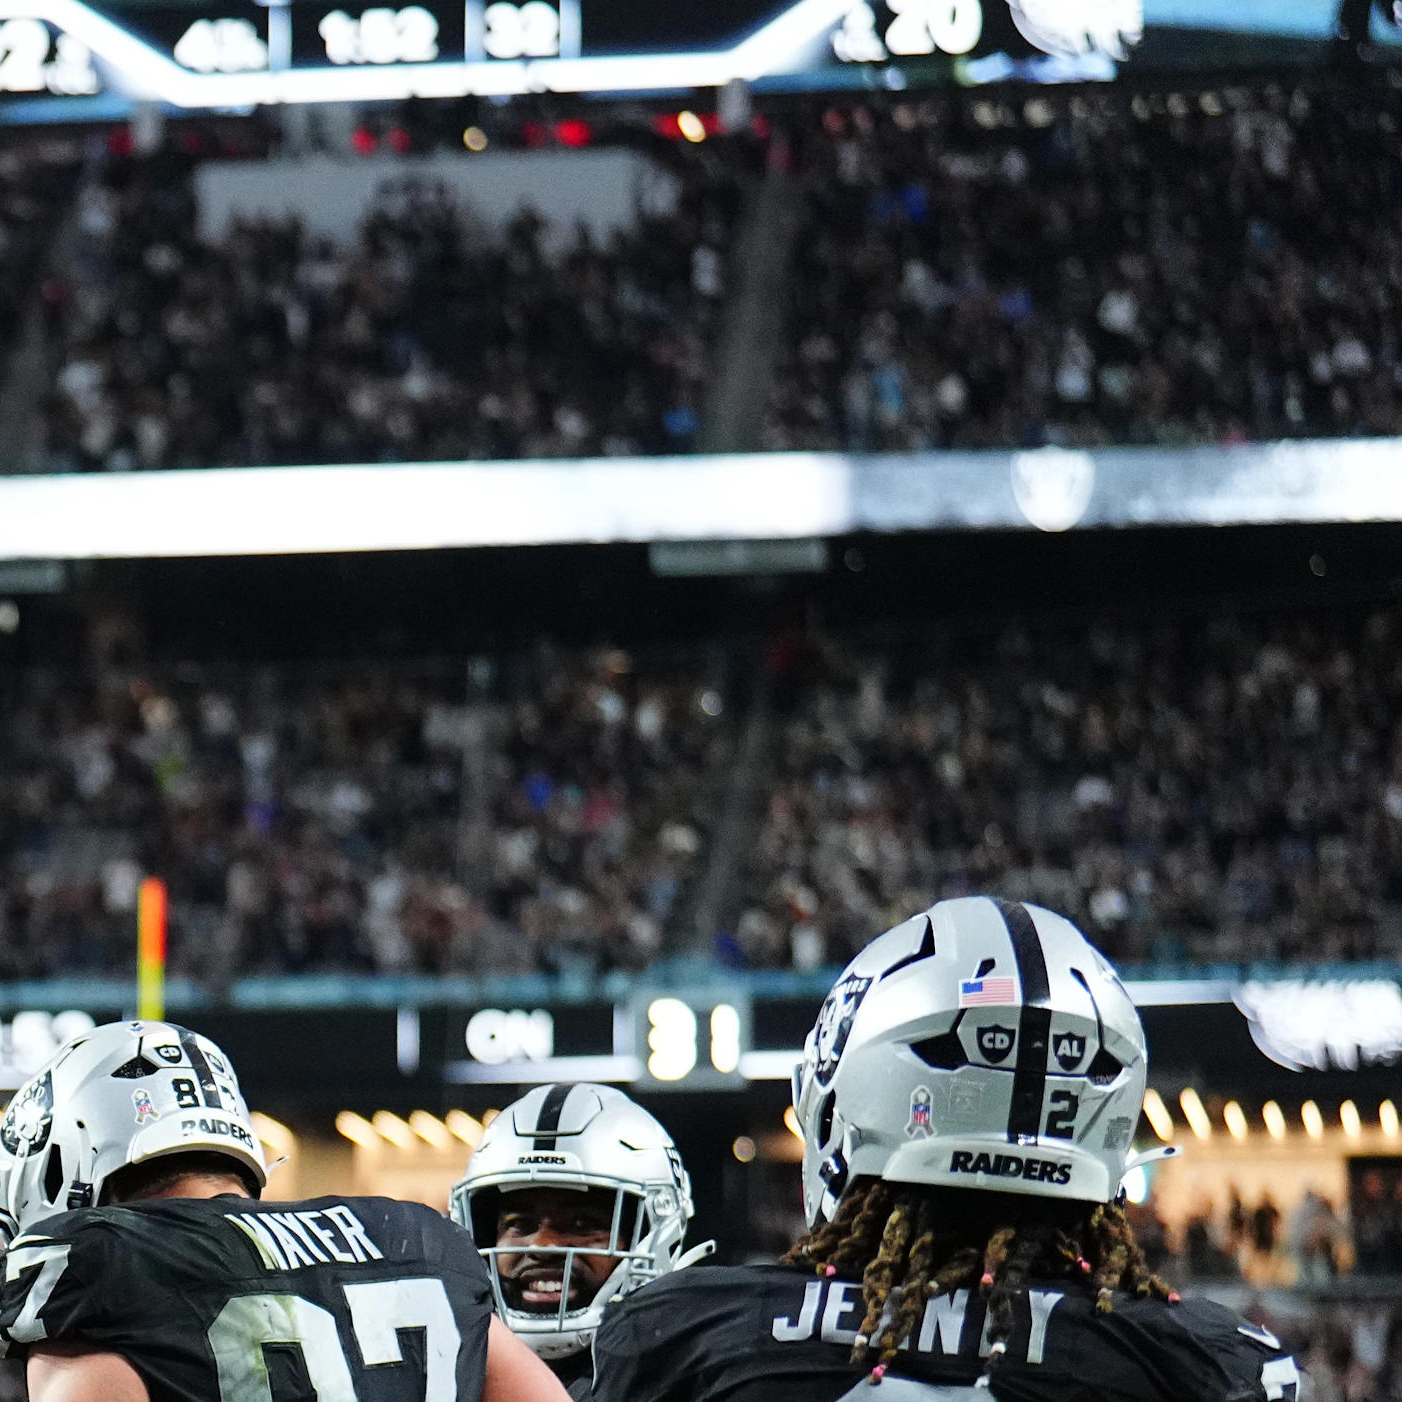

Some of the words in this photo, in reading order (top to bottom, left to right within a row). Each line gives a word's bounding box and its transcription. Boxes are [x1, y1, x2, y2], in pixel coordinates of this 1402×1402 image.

[981, 1033, 1010, 1049] CD
[1057, 1038, 1082, 1058] AL
[1045, 1090, 1079, 1140] 2
[517, 1156, 566, 1166] RAIDERS
[949, 1150, 1073, 1186] RAIDERS
[224, 1204, 385, 1271] MAYER
